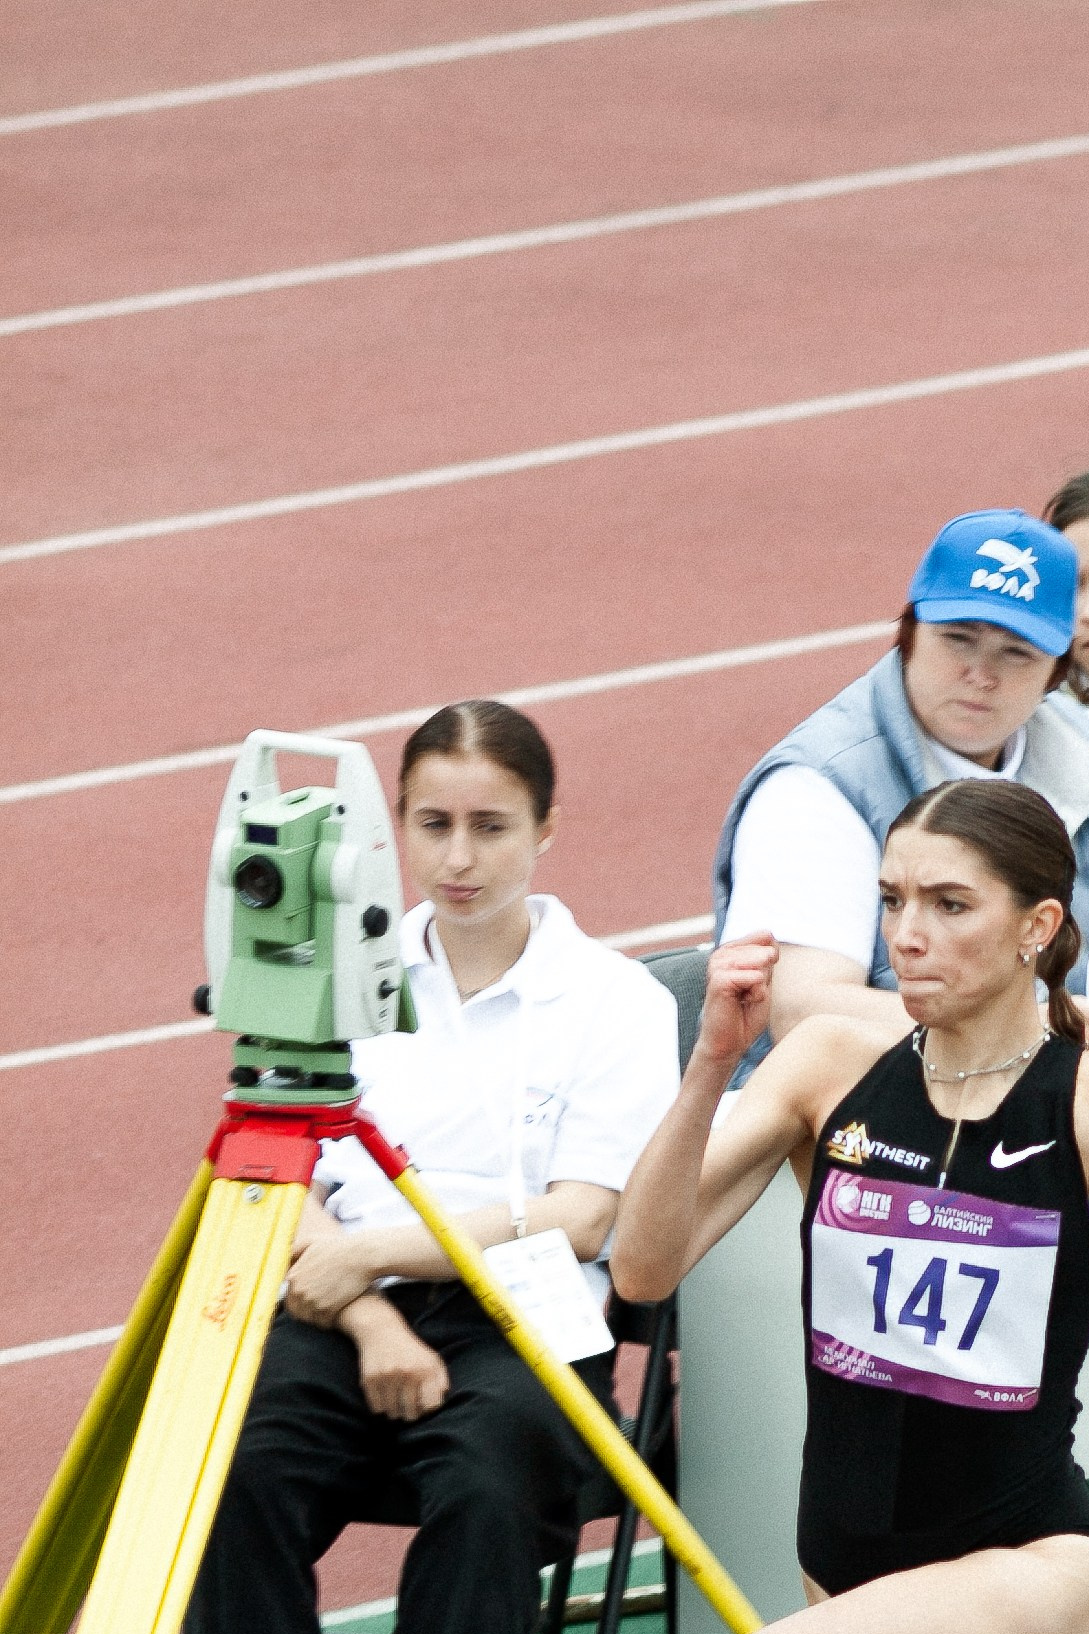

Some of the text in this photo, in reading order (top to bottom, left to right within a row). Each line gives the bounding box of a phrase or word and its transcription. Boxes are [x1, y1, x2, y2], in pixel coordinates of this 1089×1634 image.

[930, 1213, 993, 1237] ЛИЗИНГ
[933, 1204, 994, 1224] БАЛТИЙСКИЙ
[866, 1247, 1000, 1351] 147
